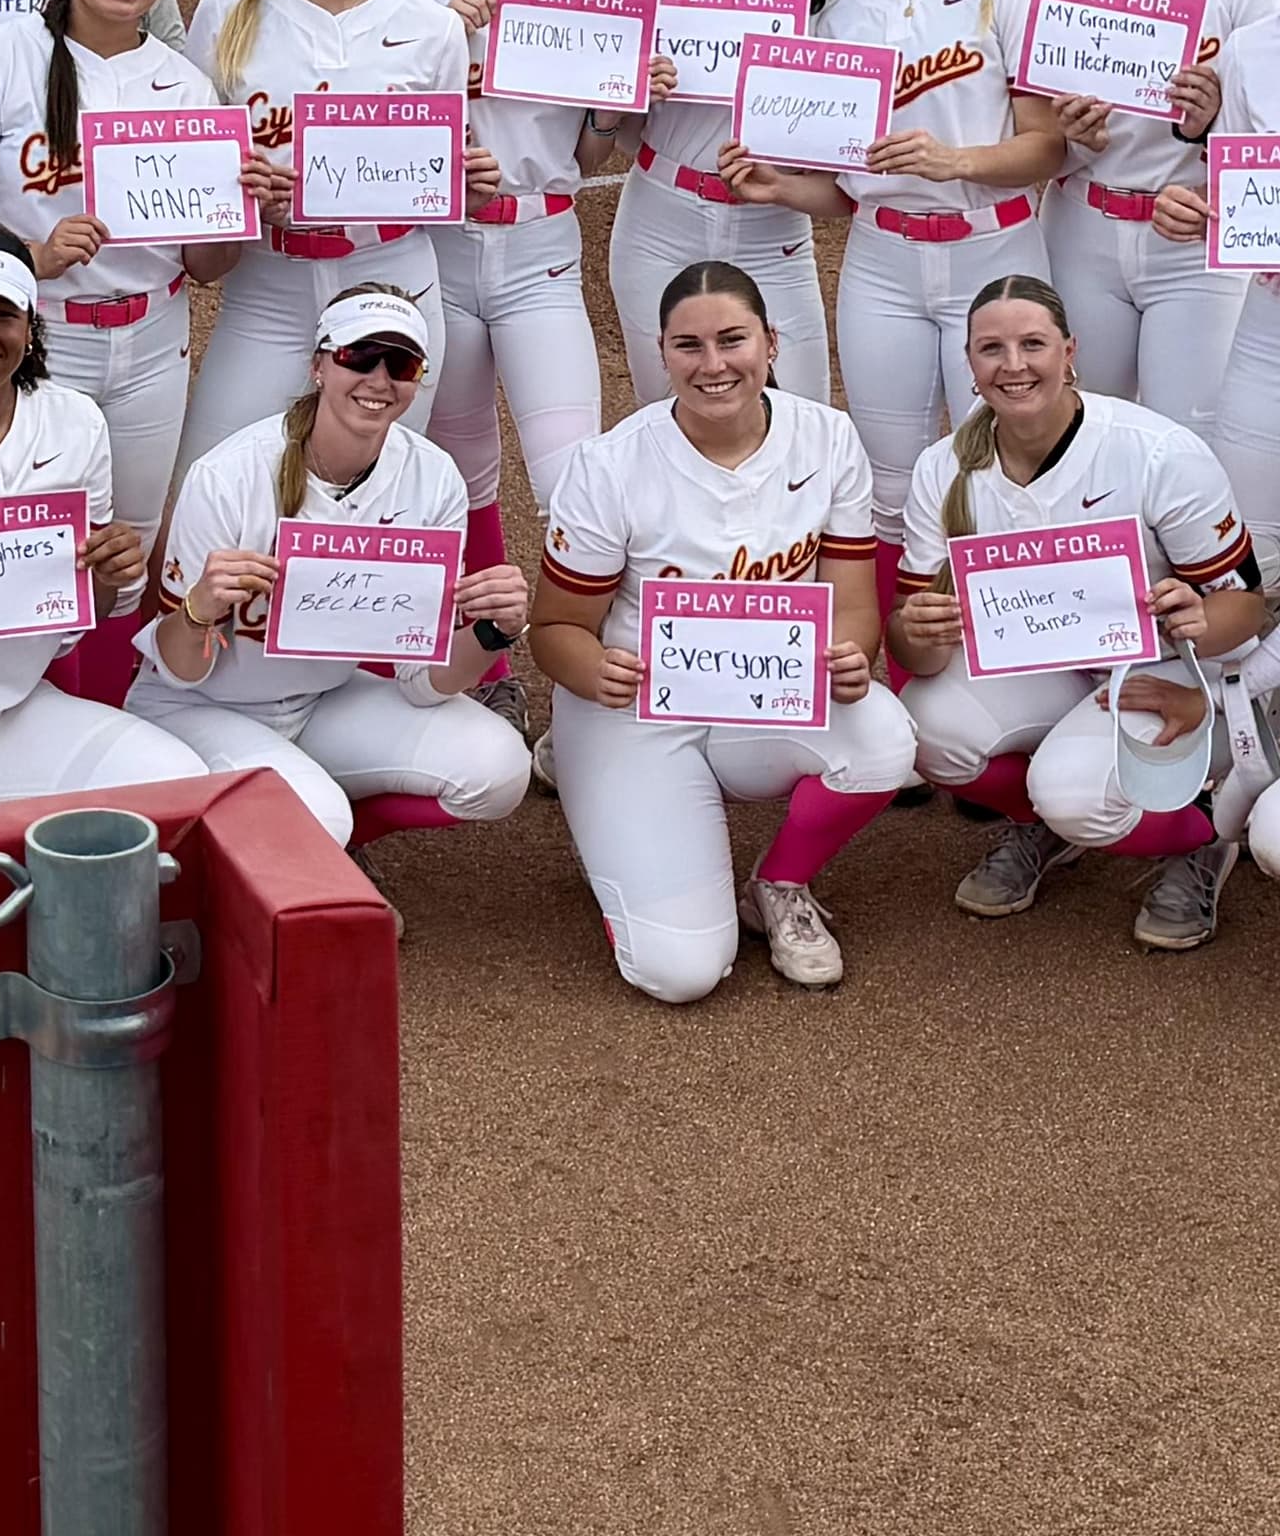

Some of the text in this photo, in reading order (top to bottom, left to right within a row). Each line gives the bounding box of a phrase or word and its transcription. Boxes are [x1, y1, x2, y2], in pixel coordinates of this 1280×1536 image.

[1079, 10, 1156, 38] Grandma
[655, 28, 741, 73] Everyo
[751, 43, 880, 74] I PLAY FOR...
[1035, 43, 1065, 67] Jill
[306, 104, 450, 120] I PLAY FOR...
[749, 95, 840, 134] everyone
[94, 118, 236, 139] I PLAY FOR...
[135, 154, 177, 178] MY
[1222, 146, 1232, 163] I
[306, 155, 428, 198] My Patients
[127, 188, 203, 220] NANA
[3, 504, 71, 524] FOR...
[291, 533, 445, 558] I PLAY FOR...
[964, 534, 1125, 567] I PLAY FOR...
[326, 571, 384, 589] KAT
[296, 594, 414, 612] BECKER
[655, 592, 813, 615] I PLAY FOR...
[979, 586, 1056, 618] Heather
[661, 646, 802, 680] everyone
